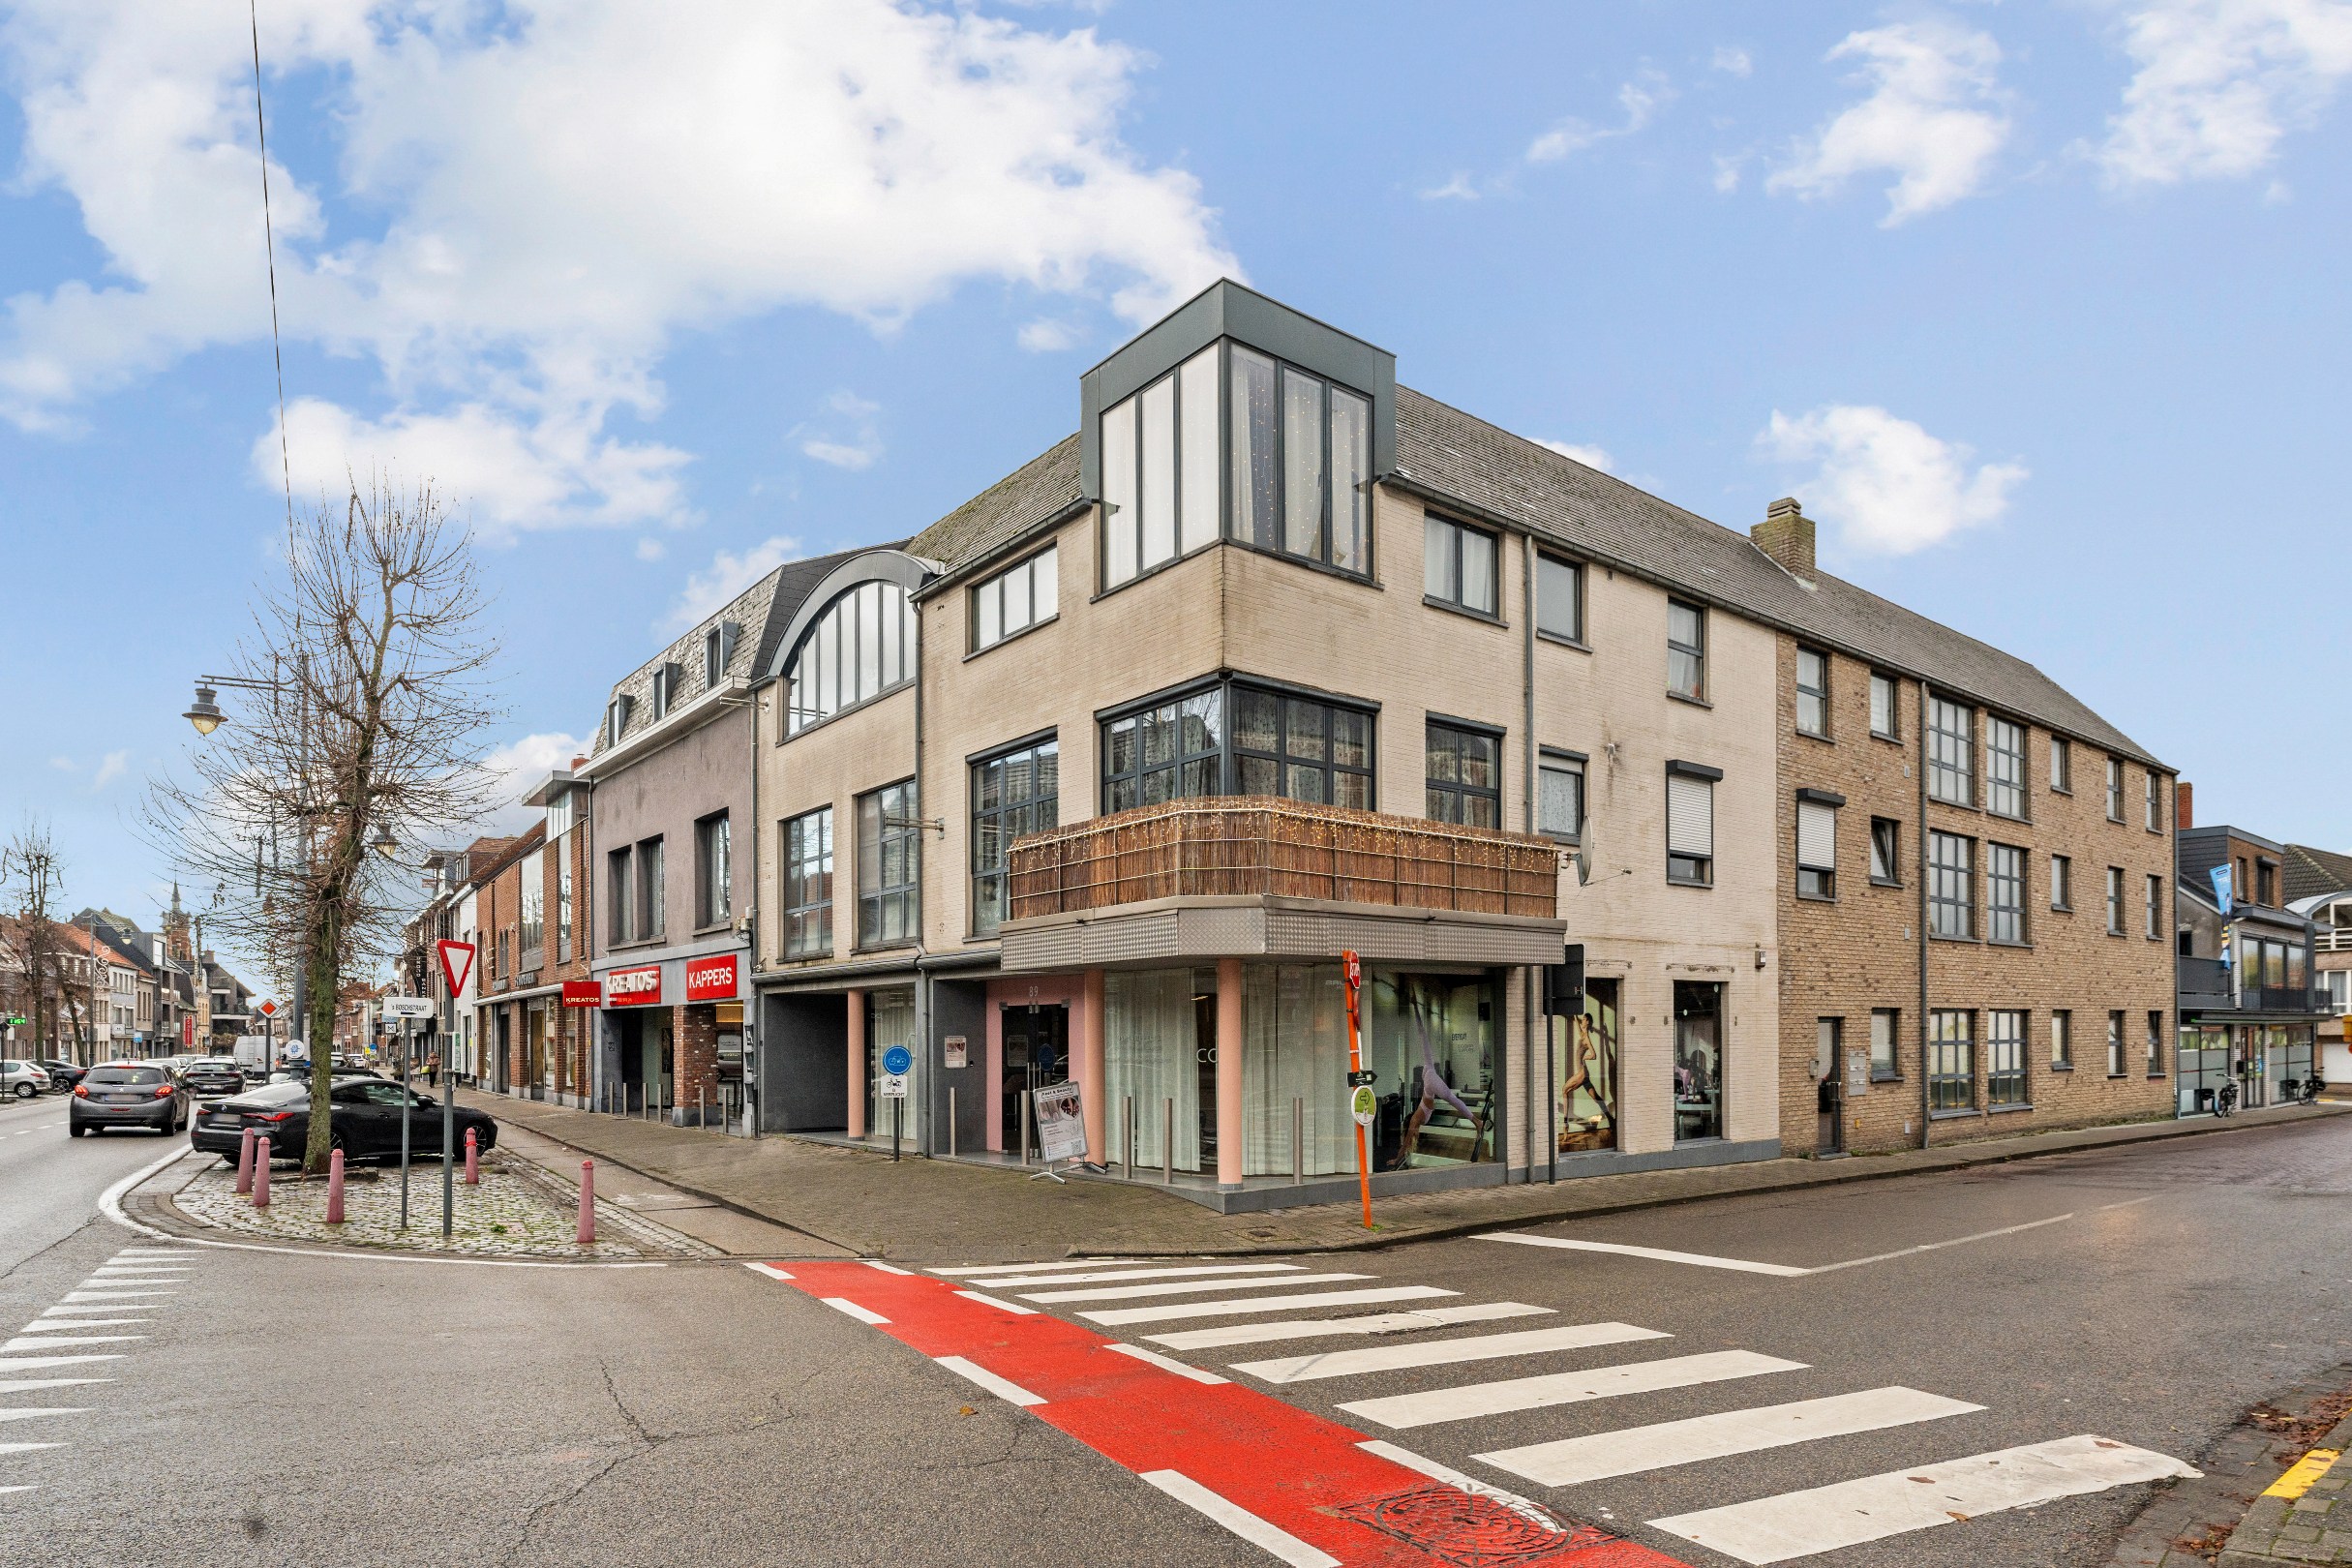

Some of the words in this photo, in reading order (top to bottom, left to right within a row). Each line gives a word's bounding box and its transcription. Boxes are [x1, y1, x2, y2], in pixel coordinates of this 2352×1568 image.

[606, 970, 657, 994] KREATOS
[688, 966, 733, 989] KAPPERS
[1029, 985, 1039, 997] 89
